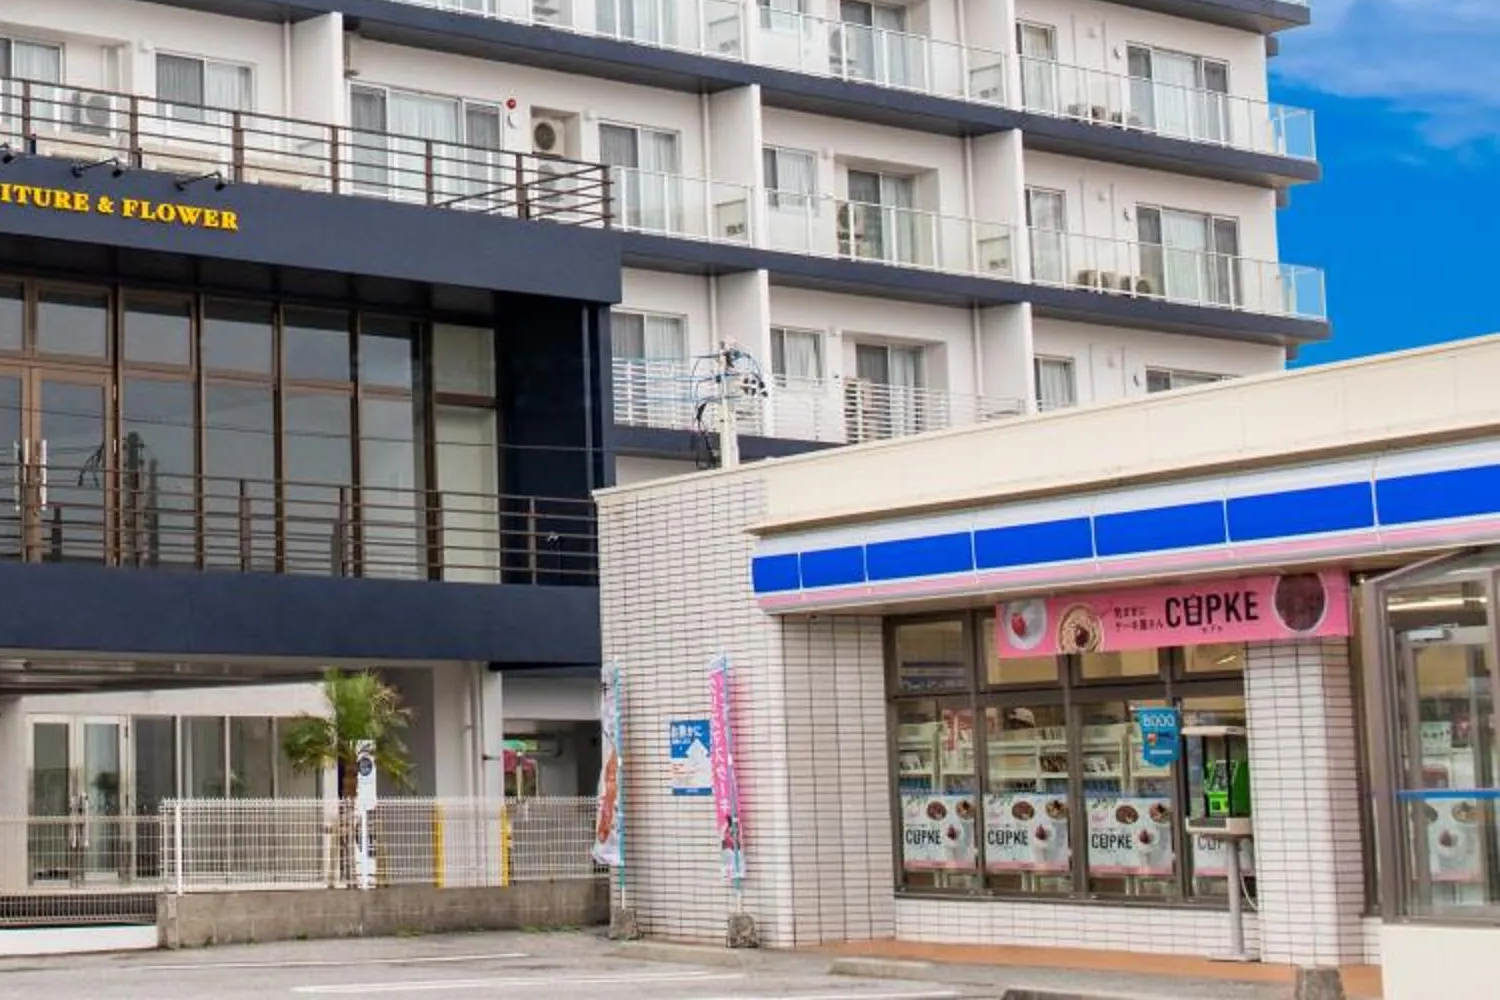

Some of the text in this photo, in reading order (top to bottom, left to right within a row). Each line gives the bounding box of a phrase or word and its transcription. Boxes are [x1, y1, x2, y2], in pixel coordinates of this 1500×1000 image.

[96, 195, 115, 214] &
[121, 197, 239, 231] FLOWER
[1165, 591, 1260, 628] CUPKE
[905, 828, 942, 845] CUPKE
[987, 829, 1029, 846] CUPKE
[1091, 833, 1133, 850] CUPKE
